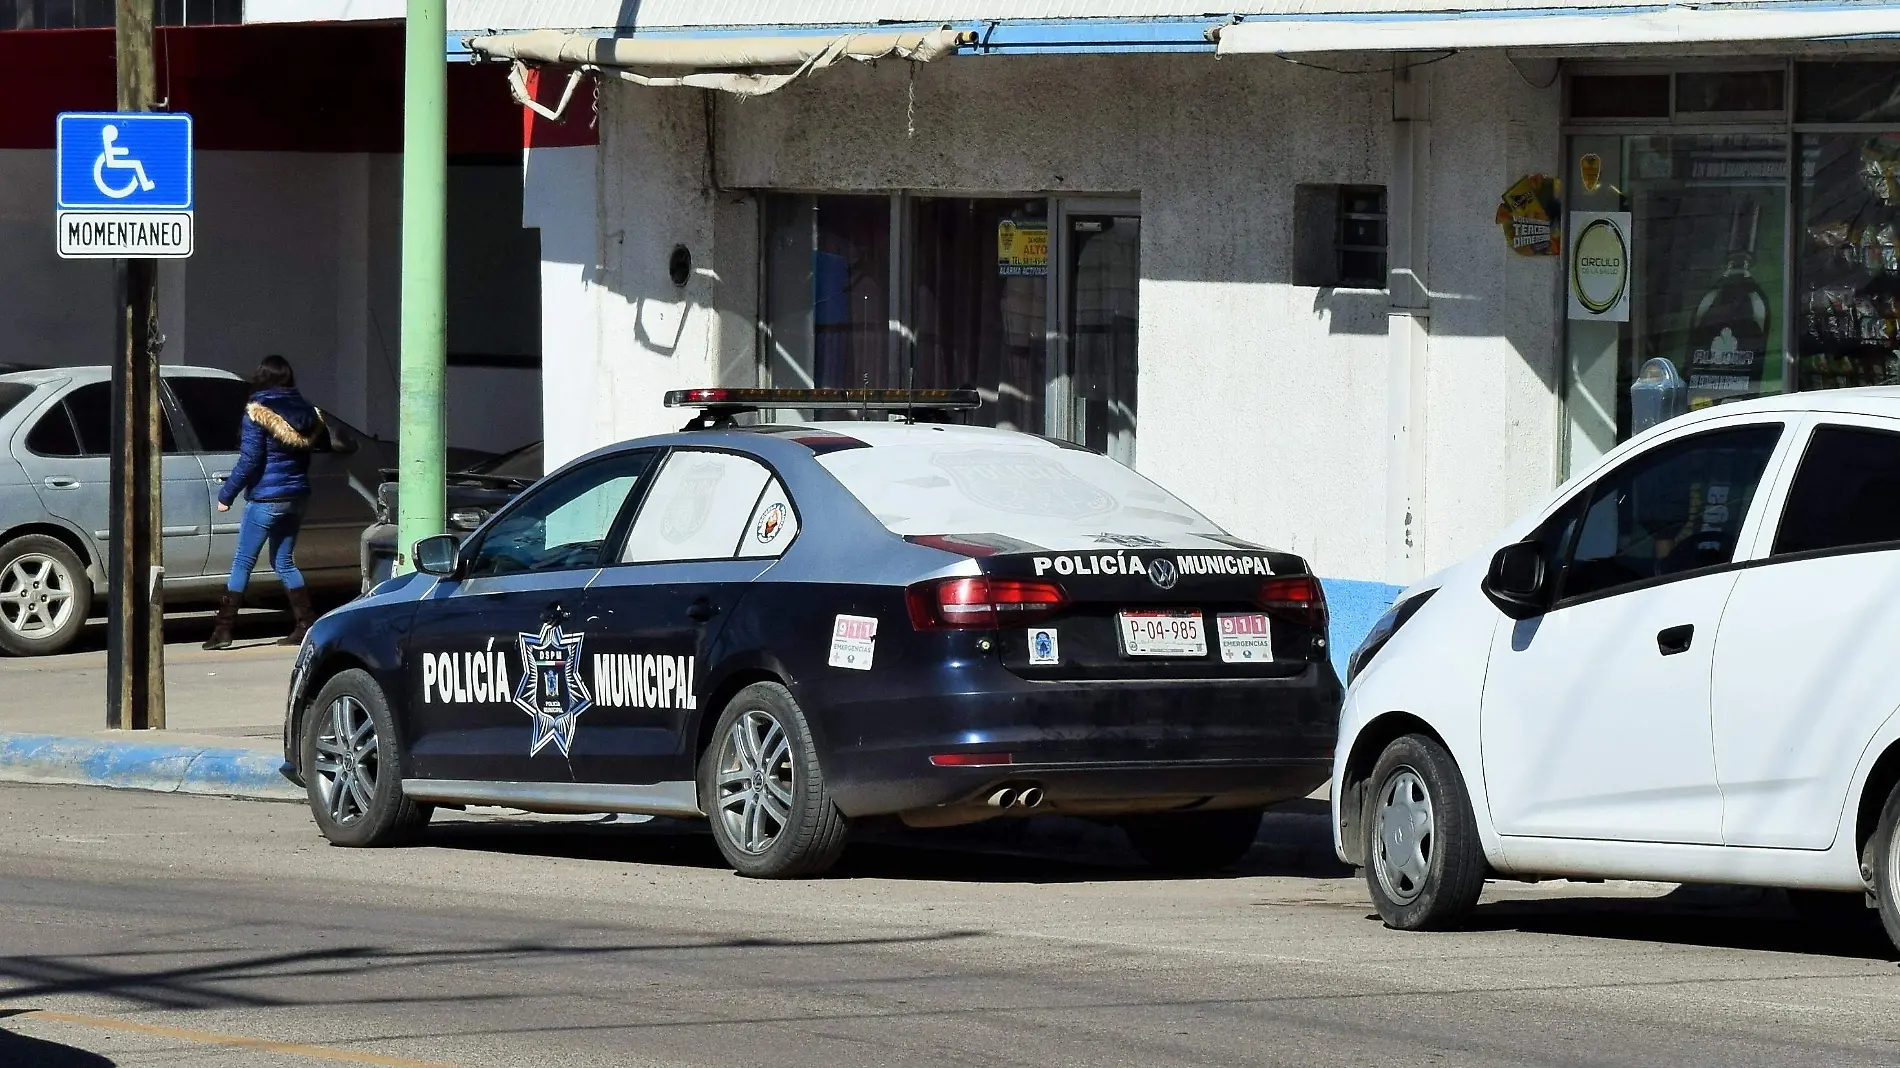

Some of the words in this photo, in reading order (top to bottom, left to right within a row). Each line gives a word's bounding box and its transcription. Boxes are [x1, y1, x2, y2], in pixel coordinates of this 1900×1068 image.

[68, 222, 182, 246] MOMENTANEO
[1033, 550, 1146, 576] POLICÍA
[1177, 555, 1275, 577] MUNICIPAL
[839, 621, 871, 638] 911
[1130, 620, 1197, 640] P-04-985
[1222, 617, 1264, 634] 911
[1223, 640, 1268, 648] EMERGENCIAS
[423, 637, 511, 704] POLICÍA
[593, 653, 697, 710] MUNICIPAL
